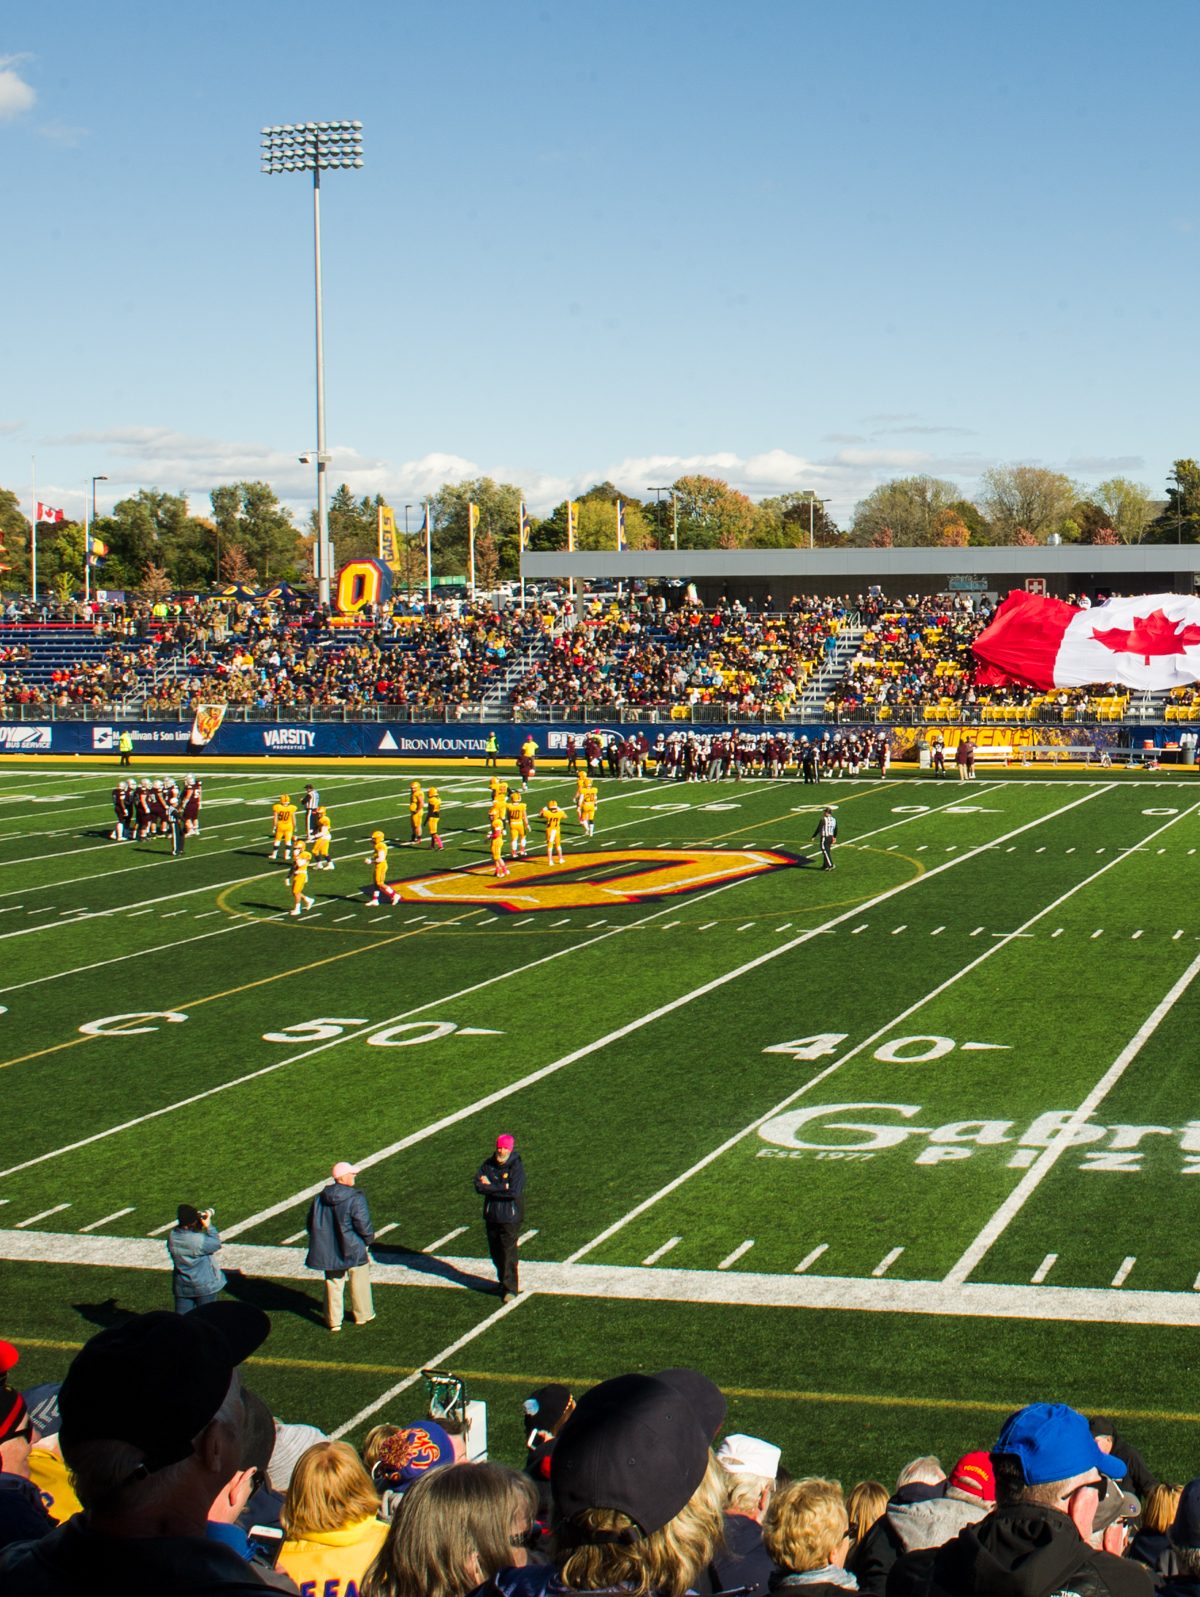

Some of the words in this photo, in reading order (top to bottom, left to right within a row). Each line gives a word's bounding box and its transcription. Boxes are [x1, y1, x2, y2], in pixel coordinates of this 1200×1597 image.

[263, 729, 316, 746] VARSITY
[401, 738, 430, 749] IRON
[78, 1012, 189, 1035] C
[262, 1018, 458, 1046] 50
[761, 1033, 956, 1063] 40
[815, 1152, 876, 1162] 1977
